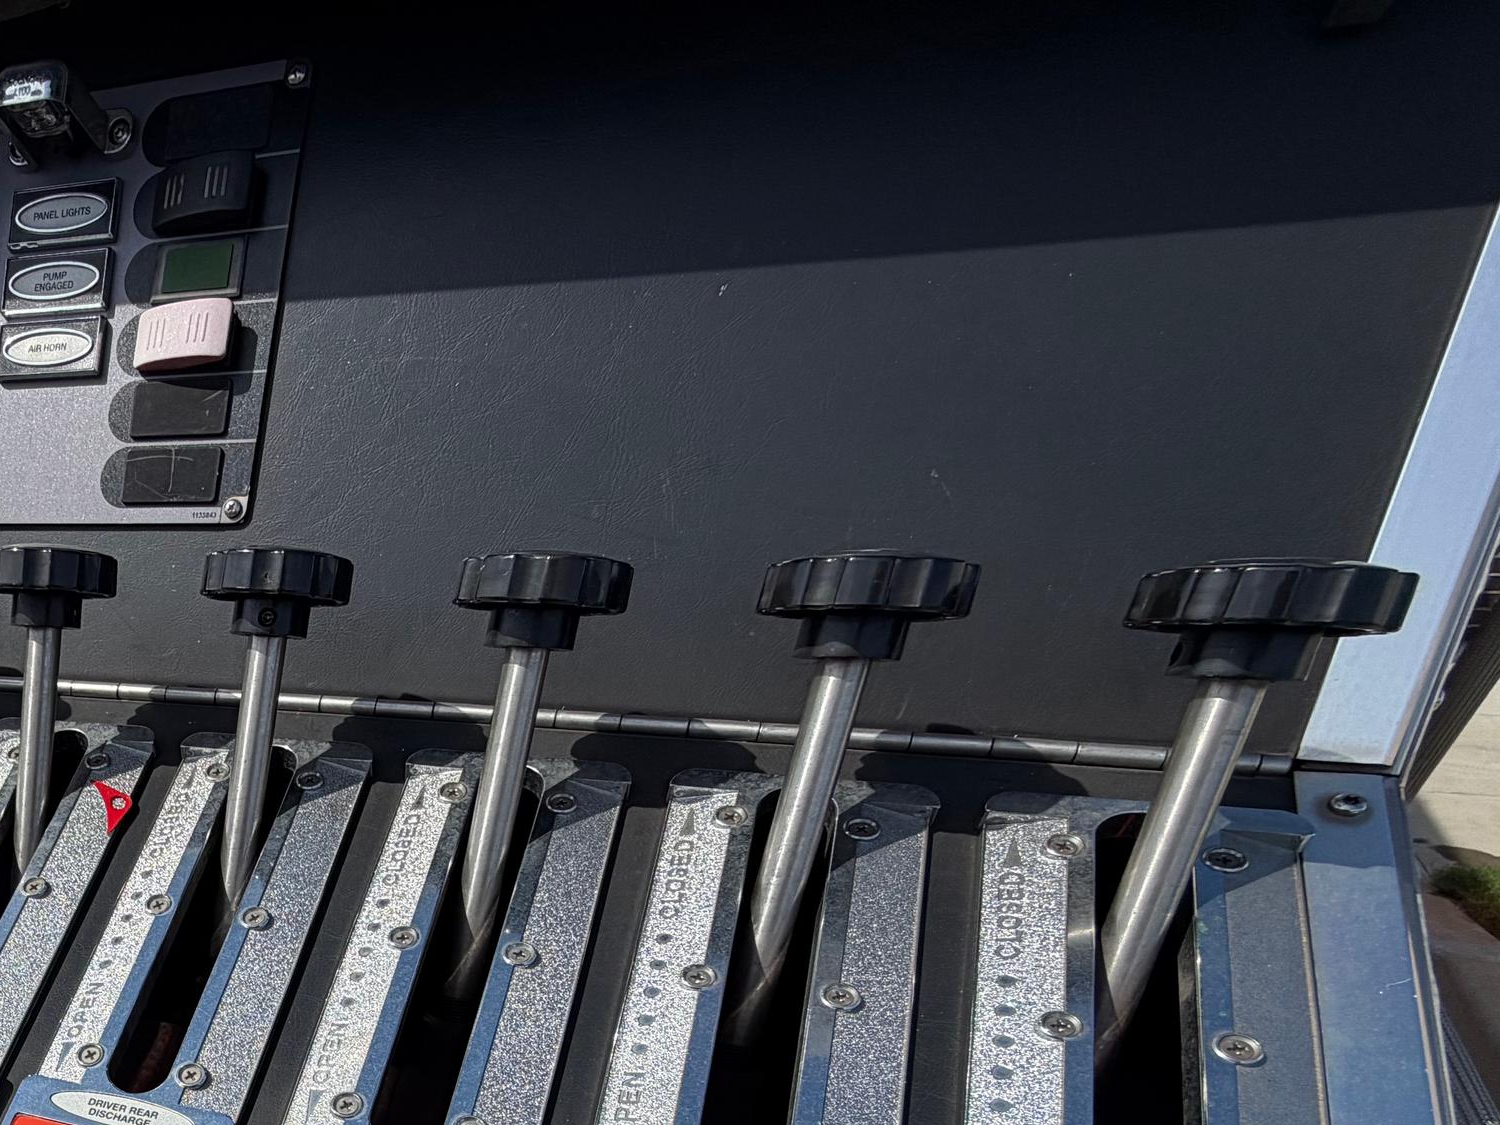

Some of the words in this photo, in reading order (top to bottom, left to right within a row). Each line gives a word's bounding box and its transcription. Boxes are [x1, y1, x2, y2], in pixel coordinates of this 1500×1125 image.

[34, 210, 59, 221] PANEL
[62, 207, 91, 217] LIGHTS
[34, 281, 74, 292] ENGAGED
[43, 272, 67, 281] PUMP
[28, 344, 42, 353] AIR
[44, 342, 67, 352] HORN
[382, 814, 421, 888] CLOSED
[659, 840, 694, 920] CLOSED
[996, 872, 1026, 961] CLOSED
[67, 981, 103, 1039] OPEN
[312, 1021, 348, 1084] OPEN
[88, 1098, 127, 1113] DRIVER
[129, 1106, 158, 1119] REAR
